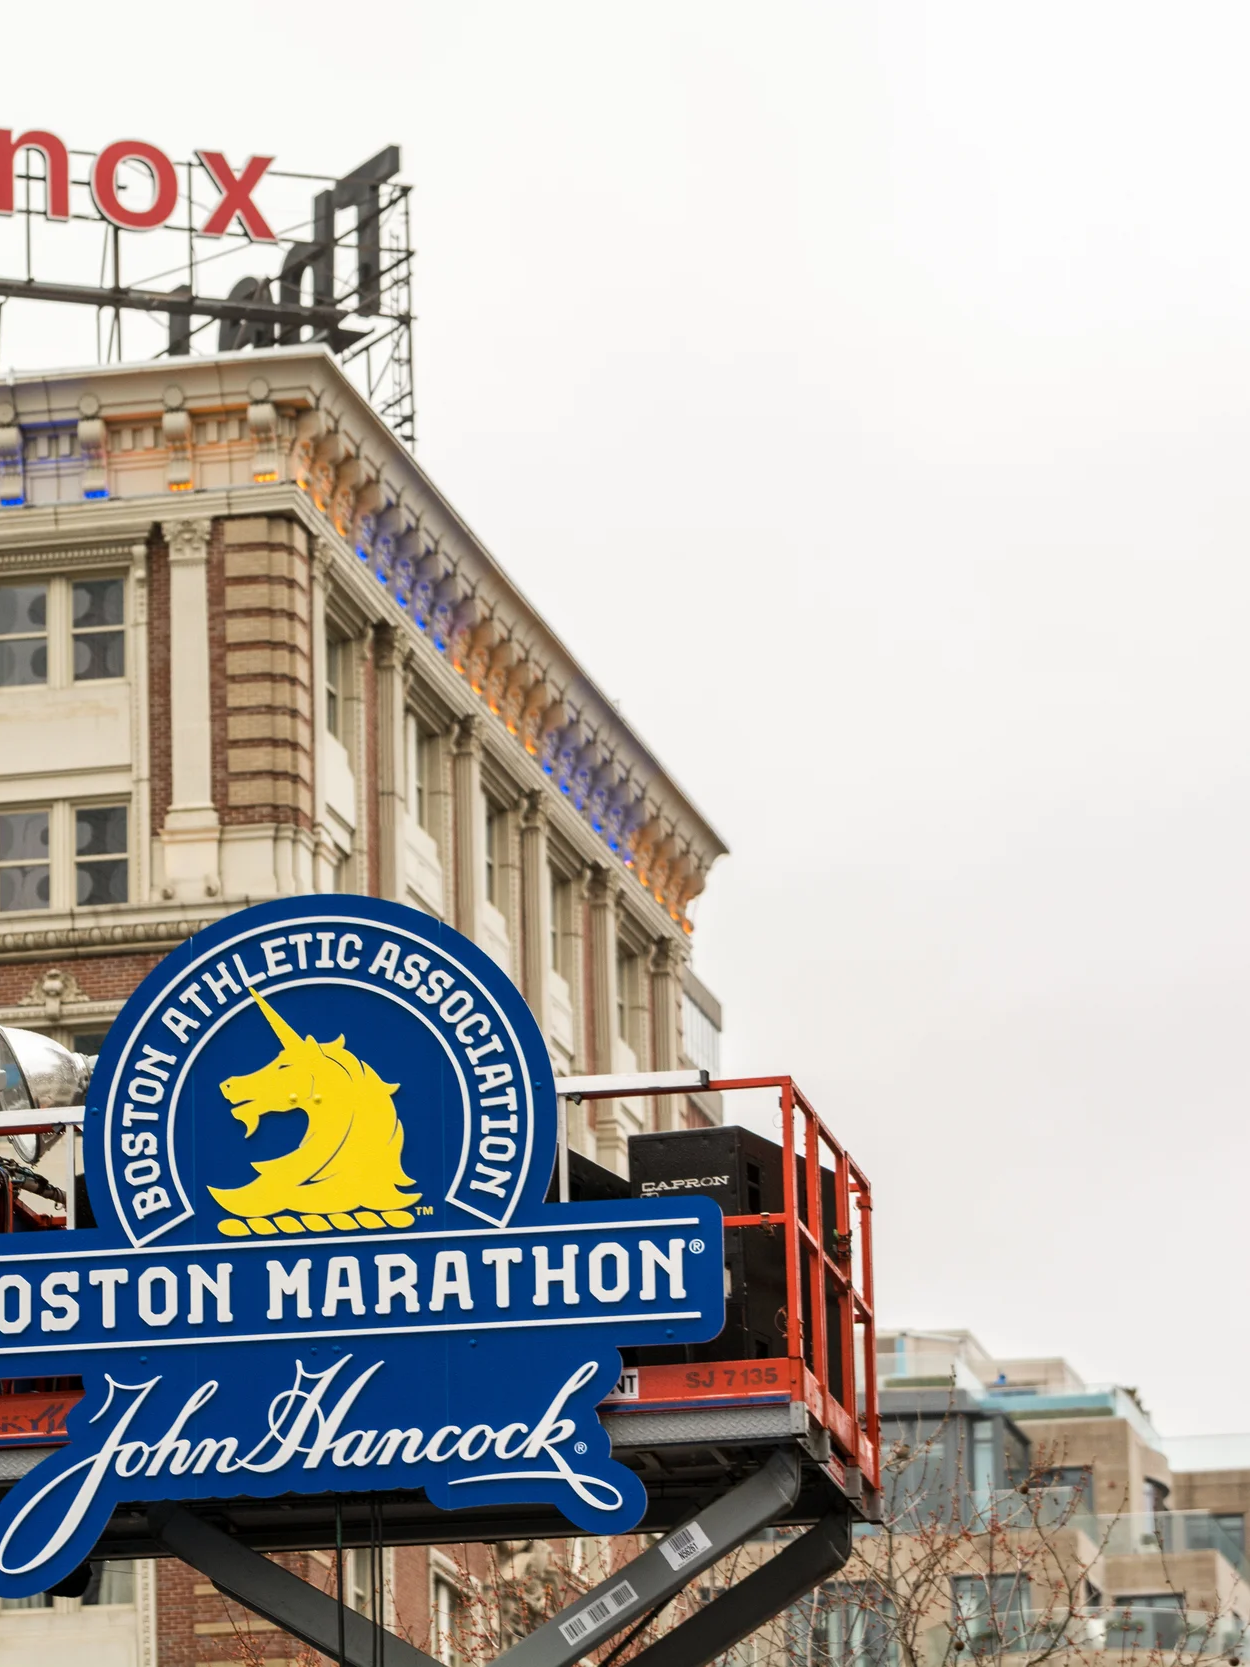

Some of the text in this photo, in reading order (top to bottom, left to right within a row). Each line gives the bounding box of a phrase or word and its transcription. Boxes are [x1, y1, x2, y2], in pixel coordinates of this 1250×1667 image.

[121, 1043, 178, 1222] BOSTON
[160, 931, 364, 1045] ATHLETIC
[367, 939, 519, 1199] ASSOCIATION
[641, 1175, 730, 1193] CAPRON
[685, 1367, 779, 1389] SJ 7135
